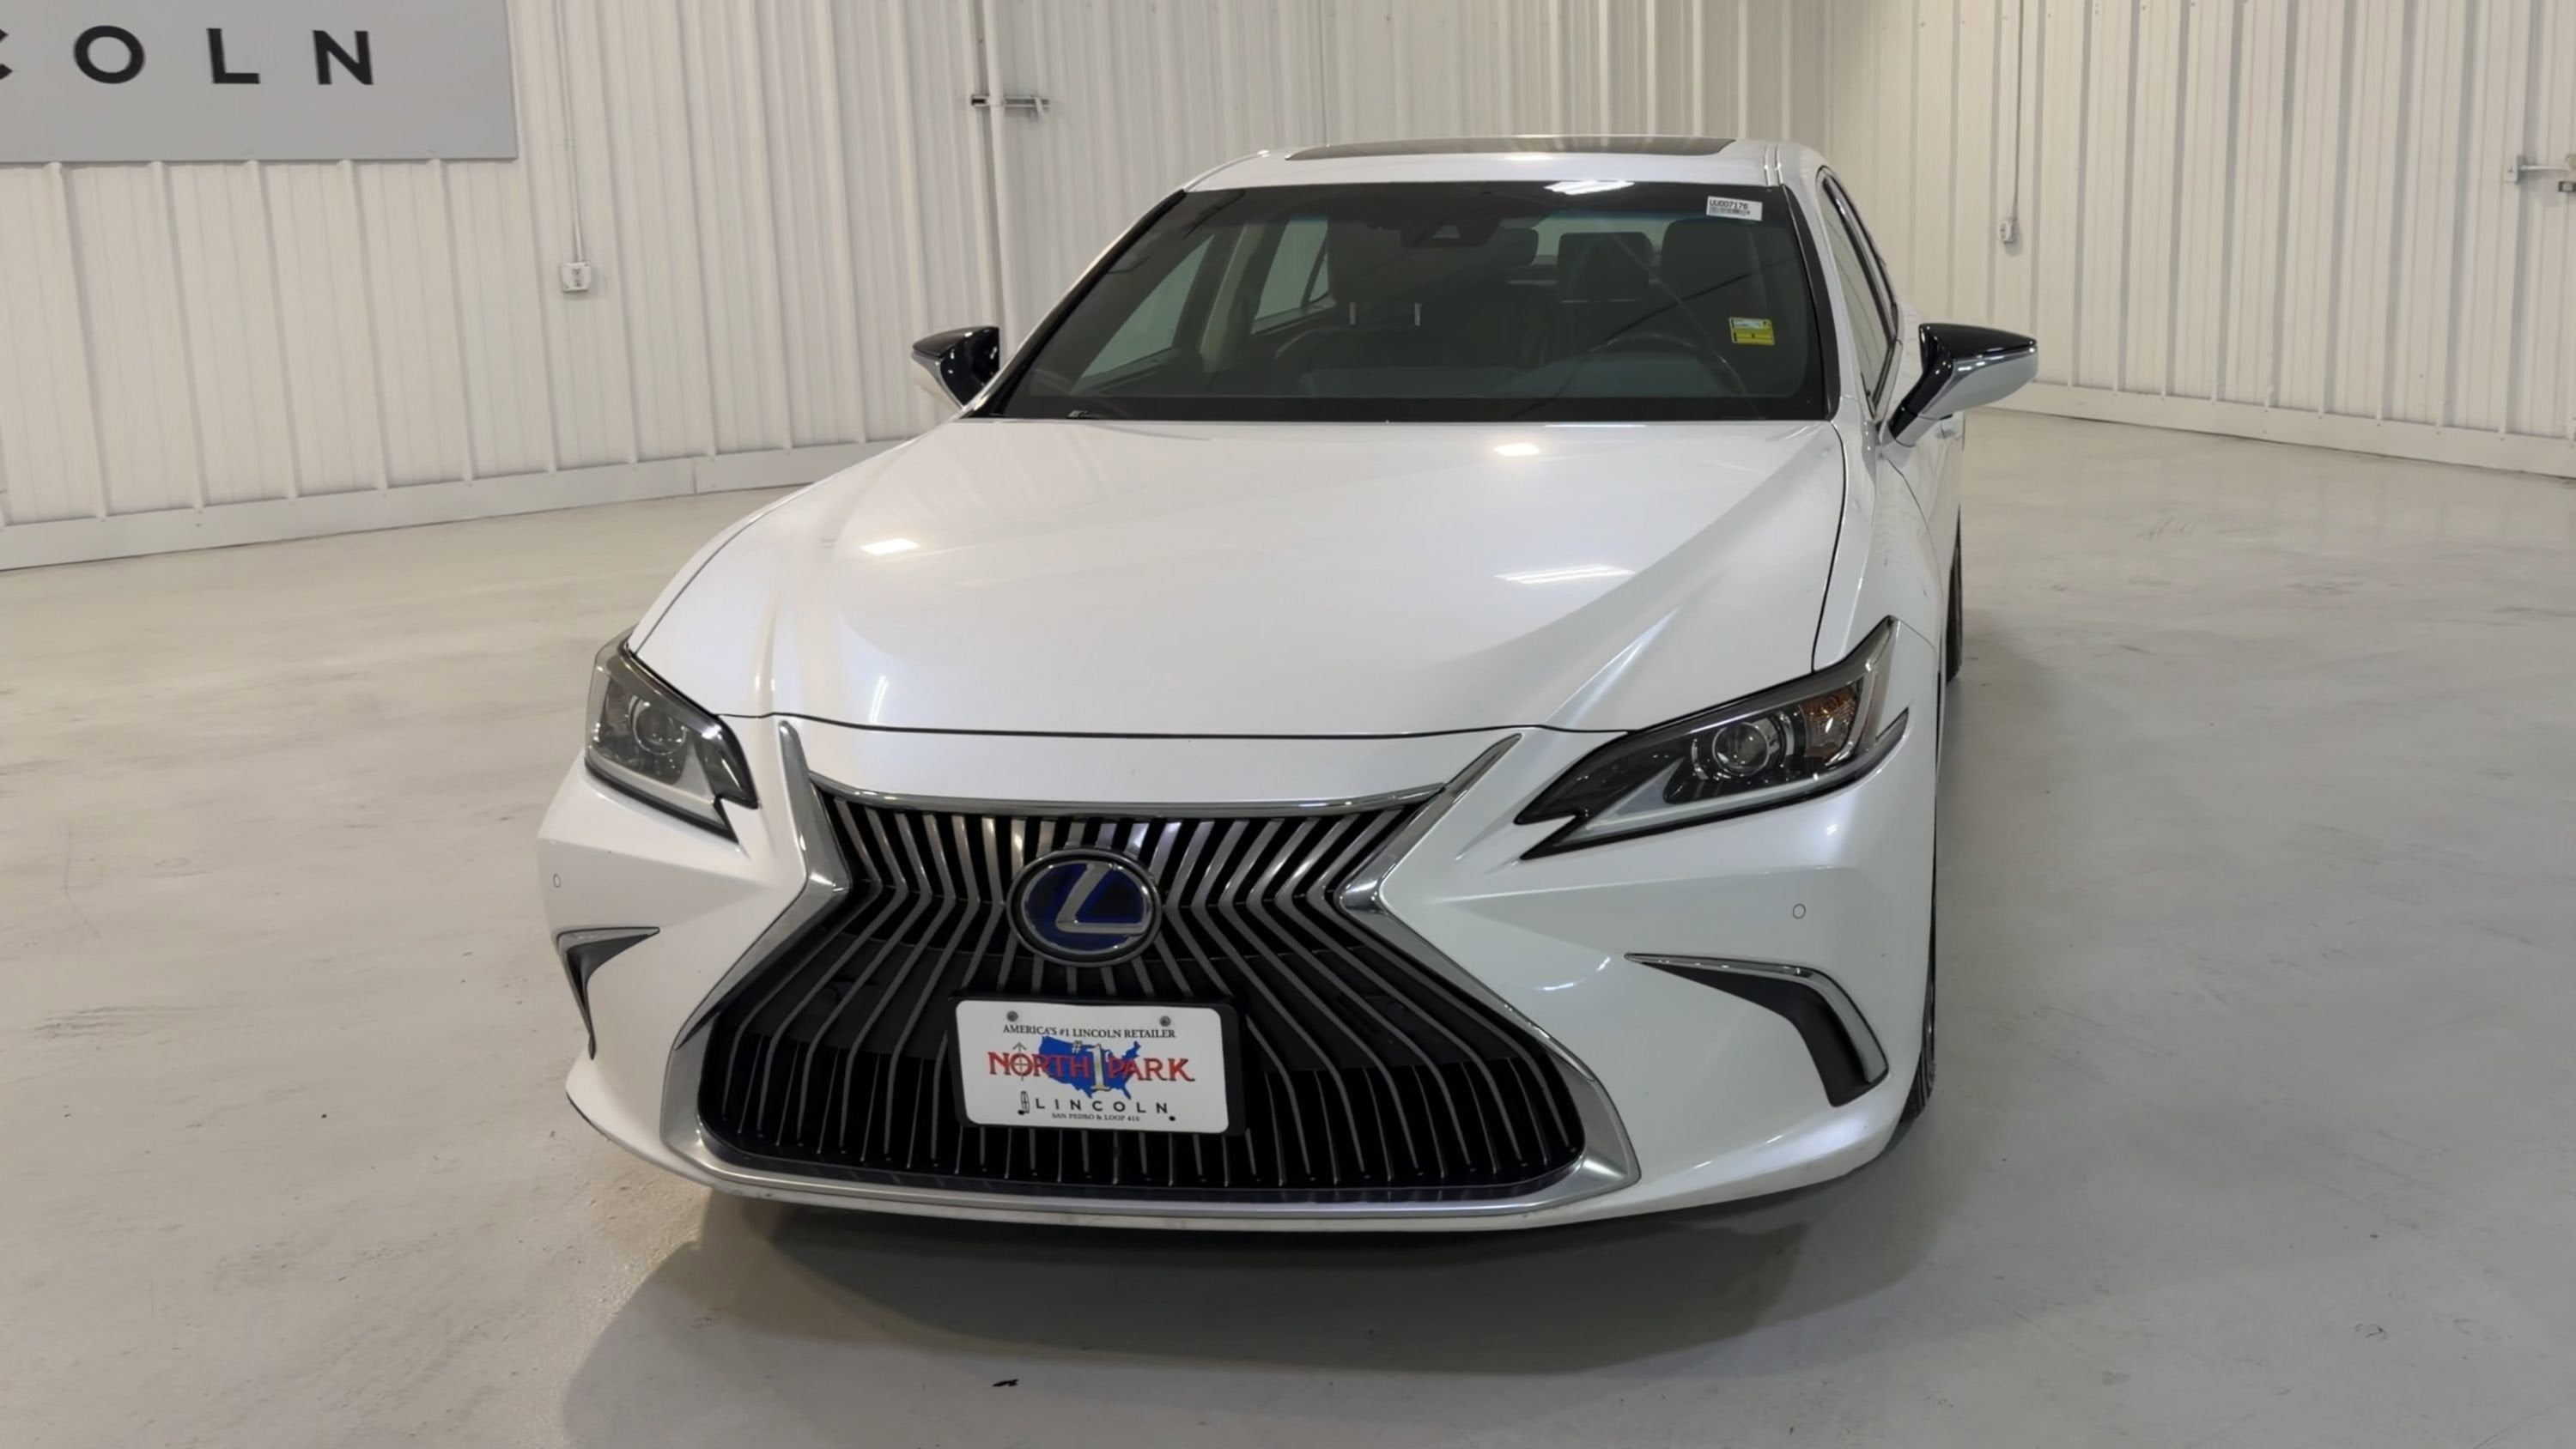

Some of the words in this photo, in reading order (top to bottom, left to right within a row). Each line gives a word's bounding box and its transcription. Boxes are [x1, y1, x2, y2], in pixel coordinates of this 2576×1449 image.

[1003, 1024, 1057, 1035] AMERICA'S
[1059, 1028, 1070, 1037] #1
[1072, 1028, 1121, 1038] LINCOLN
[1124, 1029, 1176, 1039] RETAILER
[988, 1052, 1090, 1079] NORTH
[1107, 1057, 1195, 1082] PARK
[1036, 1098, 1168, 1114] LINCOLN
